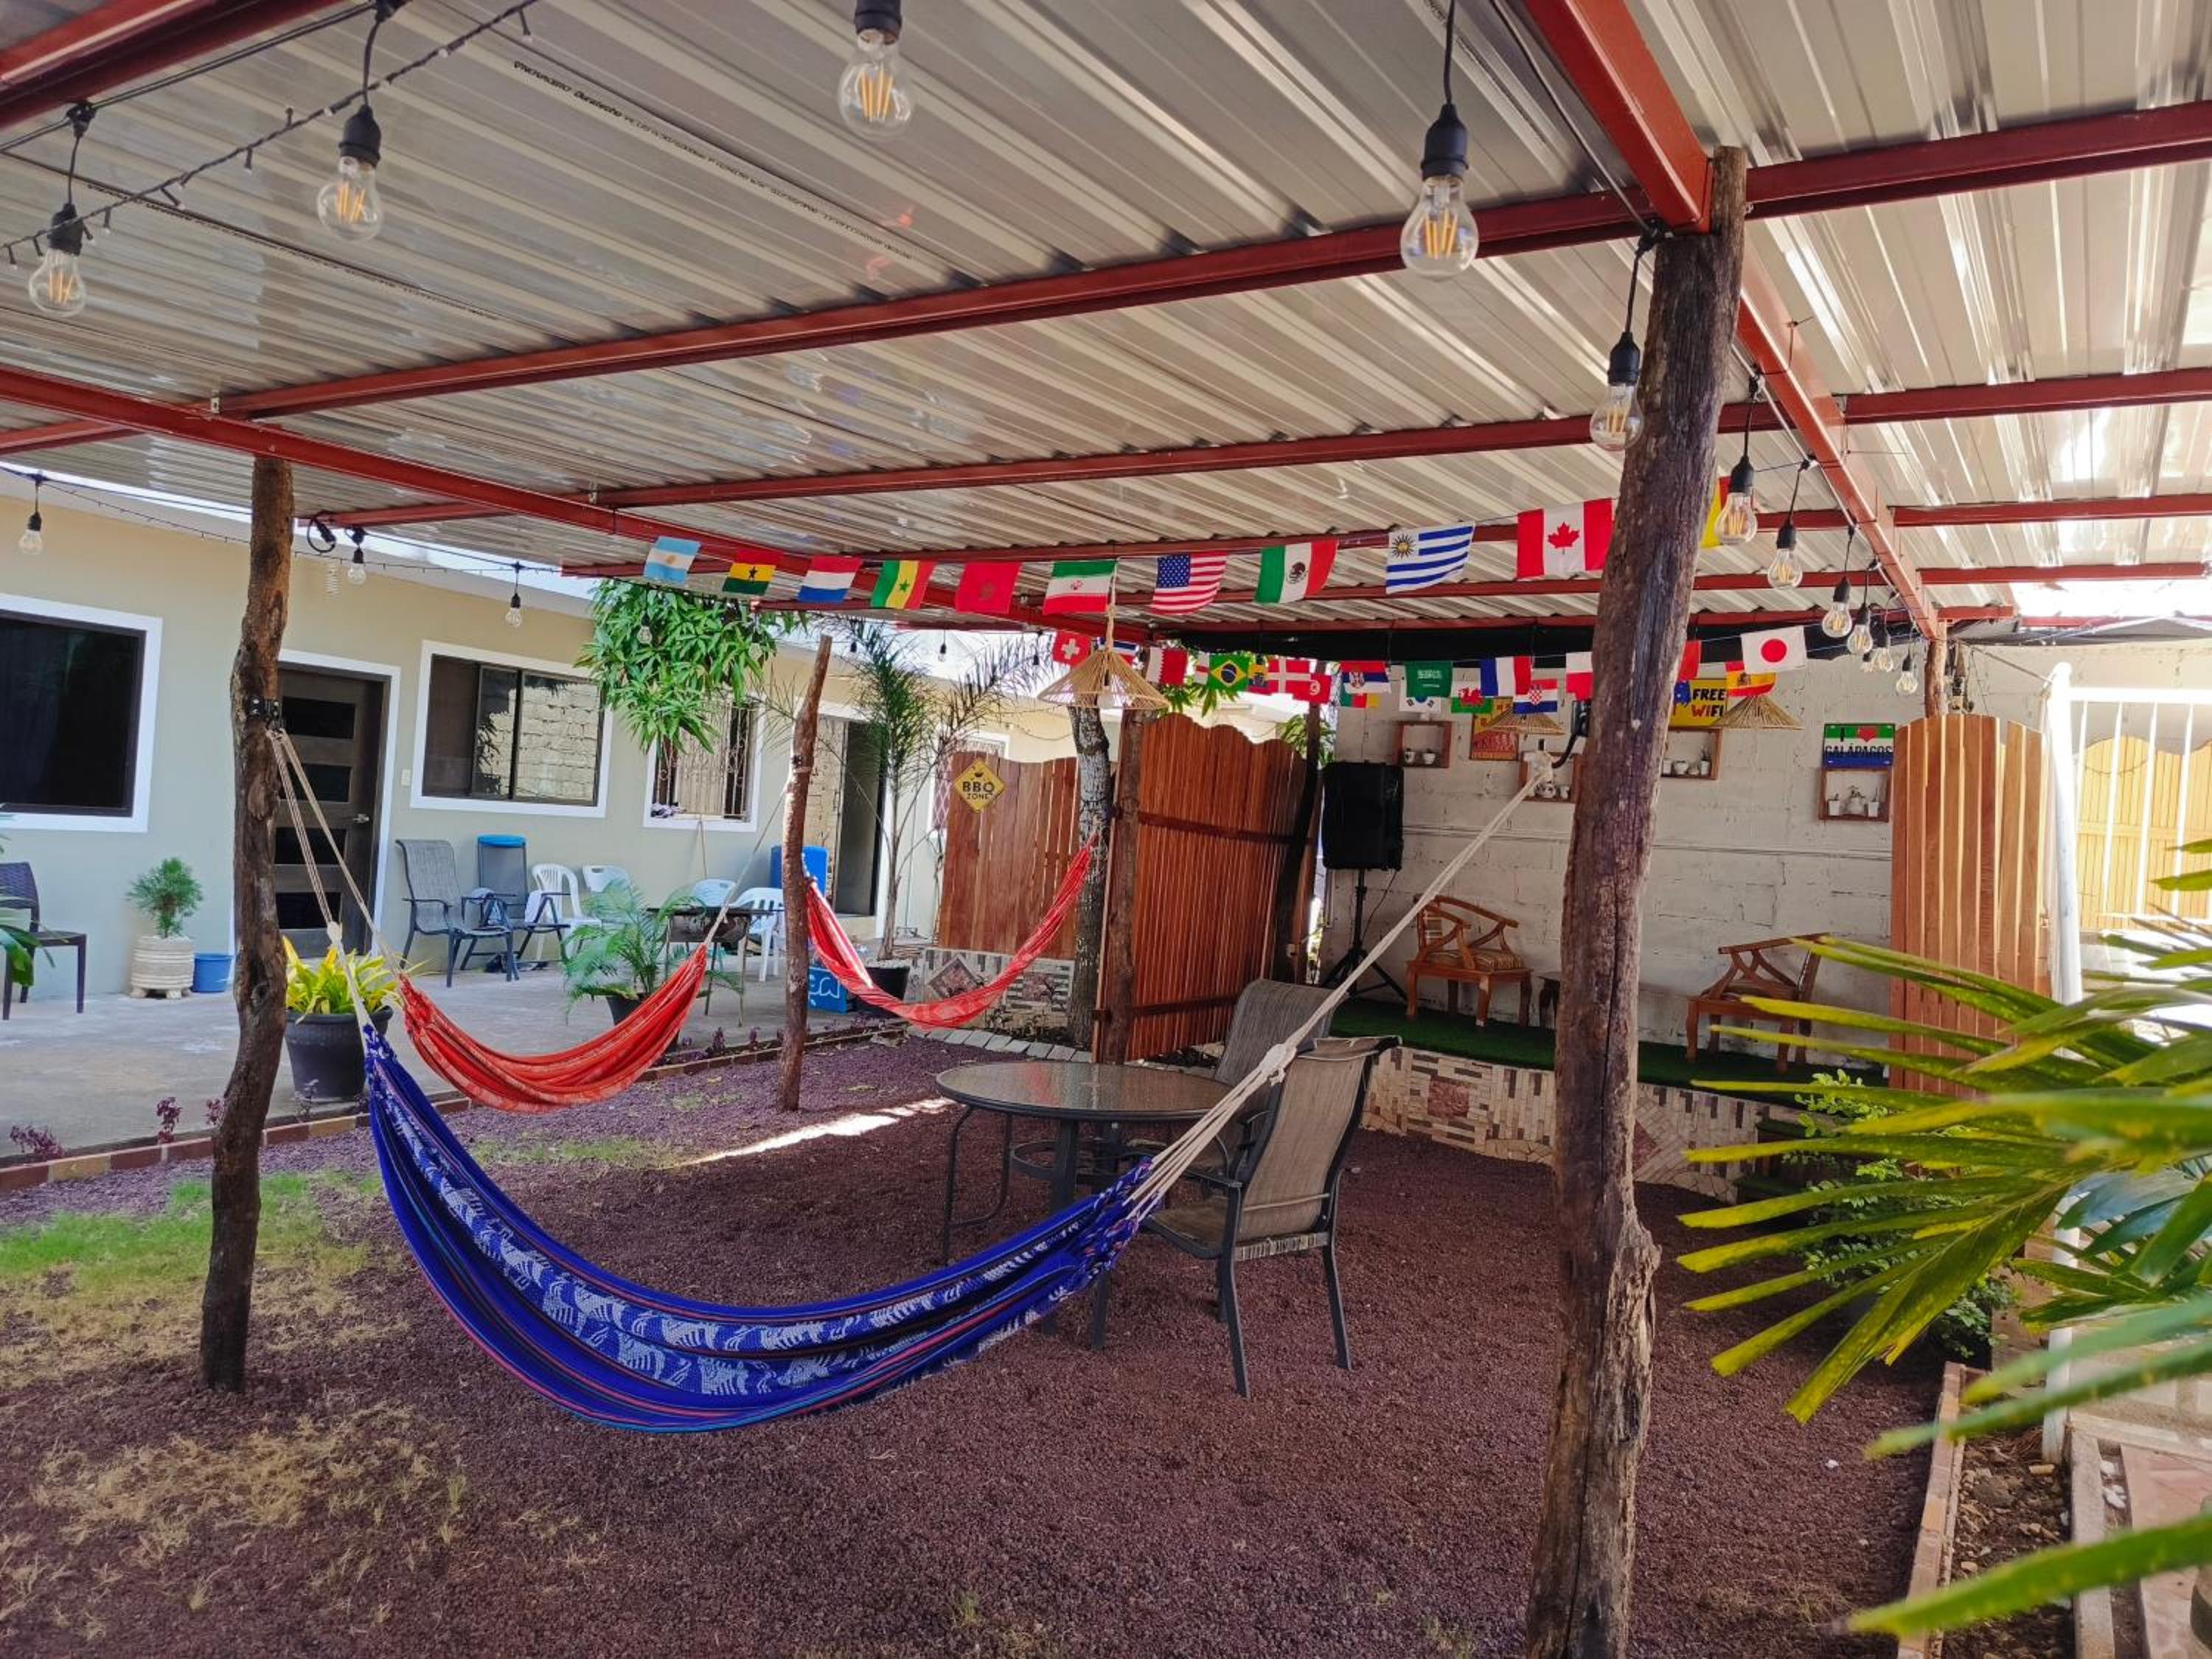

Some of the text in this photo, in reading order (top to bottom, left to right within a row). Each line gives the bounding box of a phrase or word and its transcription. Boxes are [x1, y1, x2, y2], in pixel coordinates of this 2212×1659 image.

[1692, 688, 1726, 700] FREE
[1691, 704, 1724, 717] WIFI
[1840, 727, 1846, 742] I
[962, 781, 995, 795] BBQ
